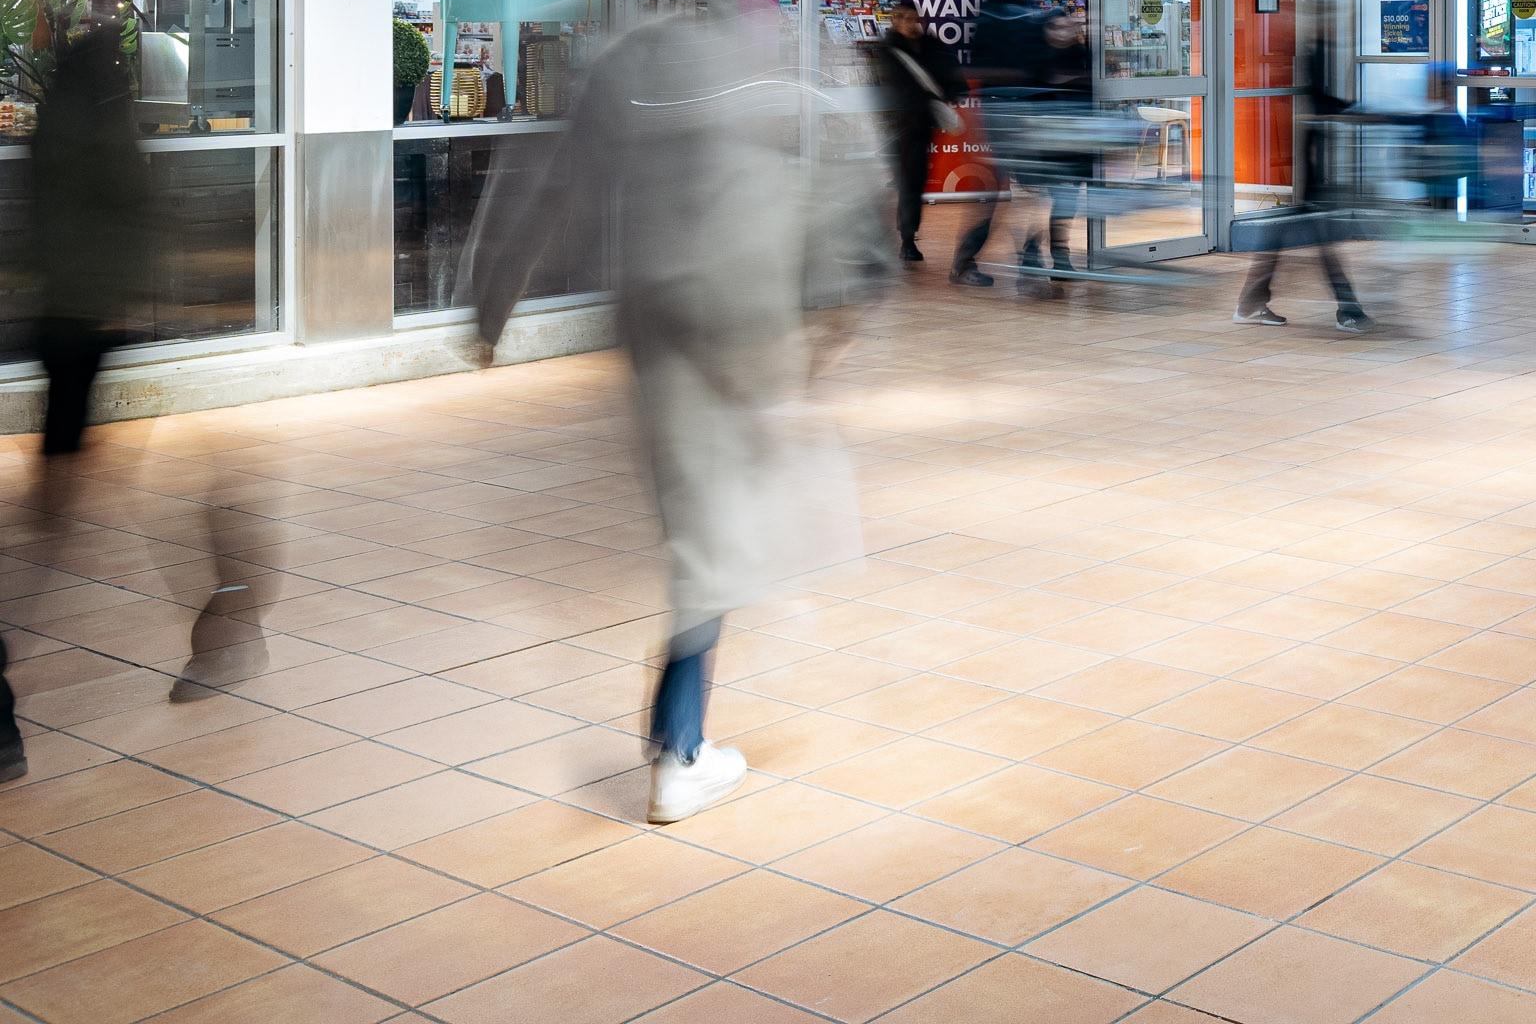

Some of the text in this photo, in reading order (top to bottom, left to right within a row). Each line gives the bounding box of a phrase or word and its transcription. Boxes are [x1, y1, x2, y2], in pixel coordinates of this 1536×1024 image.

[1383, 15, 1409, 23] $10,000
[1383, 23, 1410, 31] Winning
[942, 144, 959, 153] us
[963, 142, 992, 153] how.
